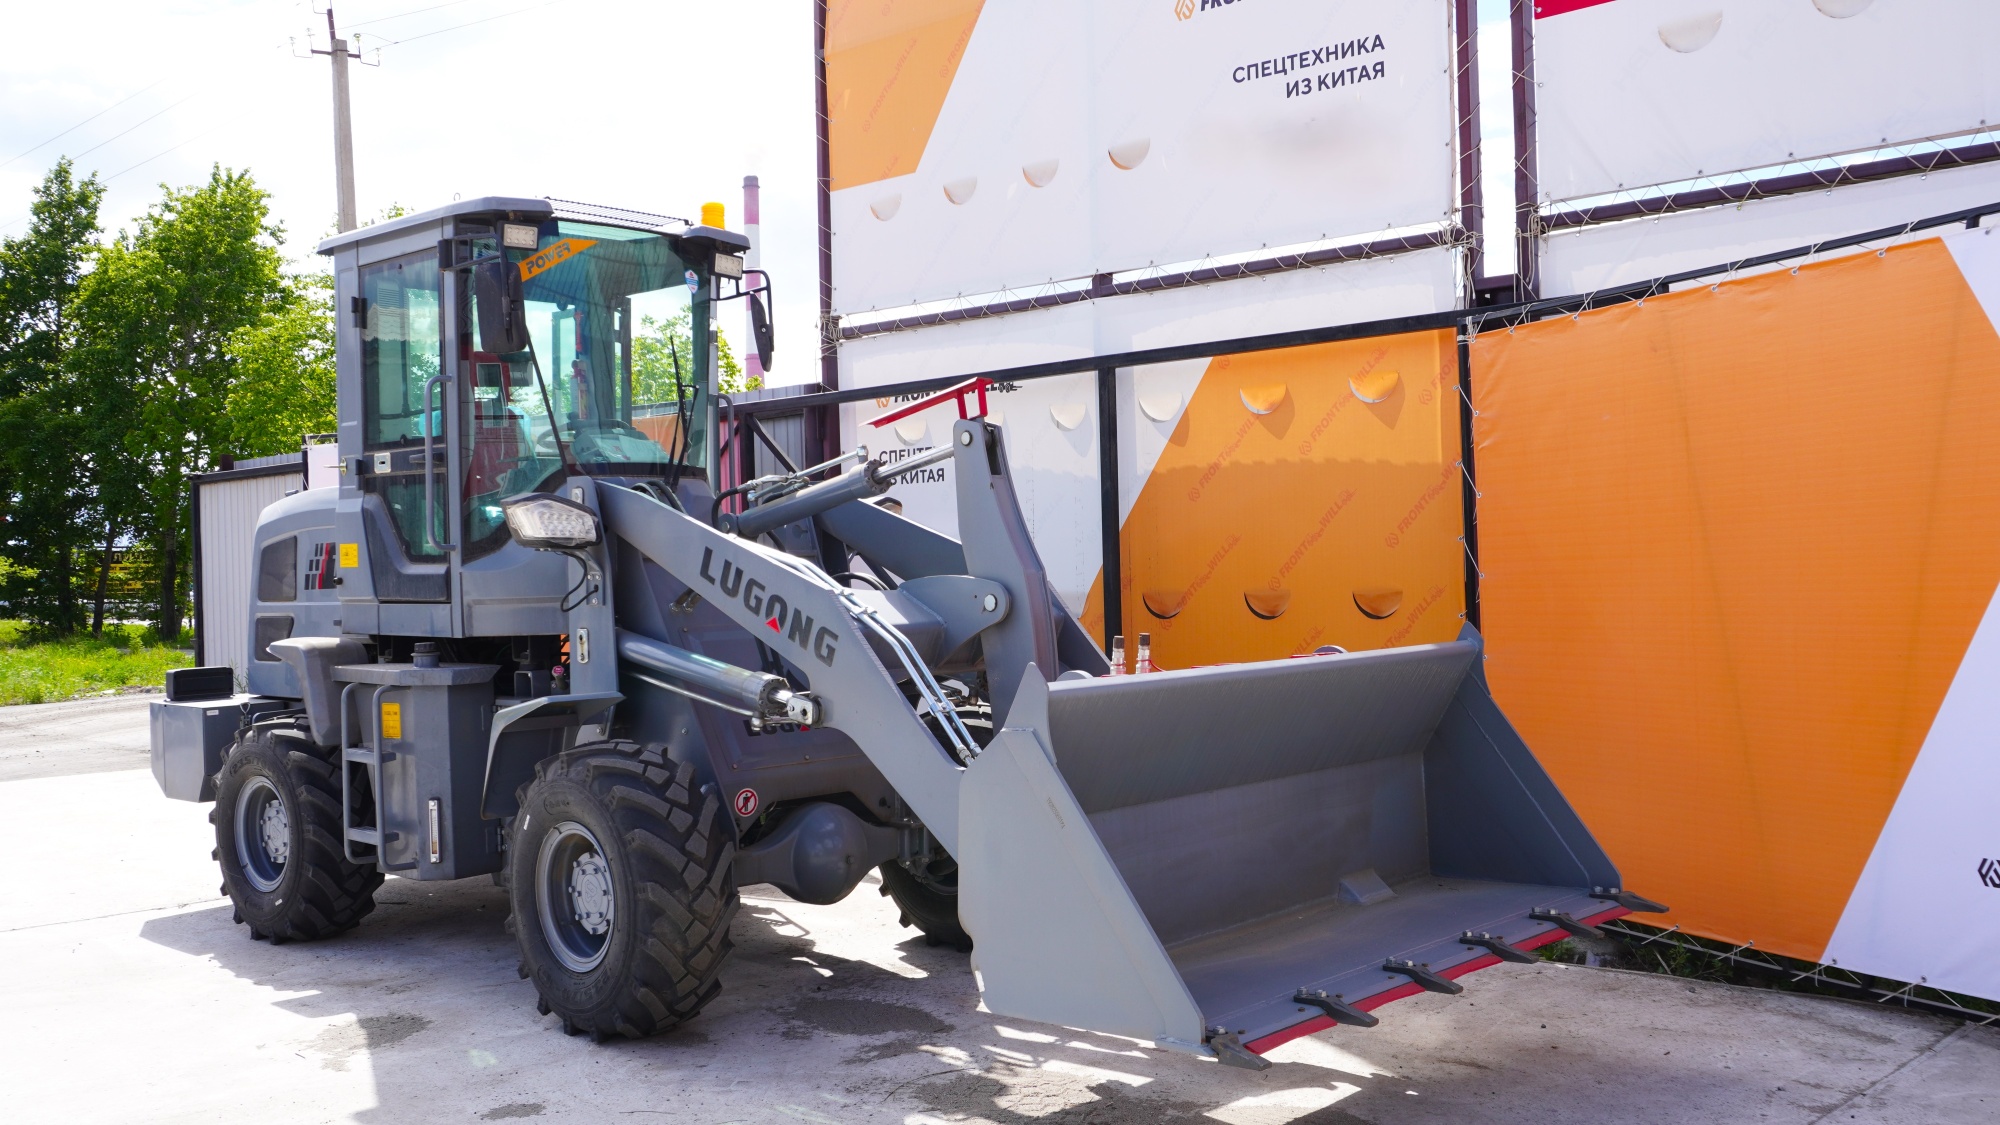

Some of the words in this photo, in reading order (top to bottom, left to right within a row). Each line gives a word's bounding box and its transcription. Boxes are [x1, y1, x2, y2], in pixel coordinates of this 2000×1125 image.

[1232, 34, 1385, 83] СПЕЦТЕХНИКА
[1286, 77, 1313, 99] ИЗ
[1318, 60, 1385, 92] КИТАЯ
[525, 242, 571, 275] POWER
[1431, 349, 1458, 390] FRON
[1310, 405, 1341, 442] FRONT
[901, 467, 945, 485] КИТАЯ
[1199, 451, 1228, 489] FRONT
[1397, 494, 1430, 534] FRONT
[1206, 546, 1229, 571] WILL
[1279, 540, 1308, 578] FRONT
[1319, 501, 1342, 528] WILL
[700, 546, 839, 668] LUGONG
[1407, 597, 1433, 625] WILL
